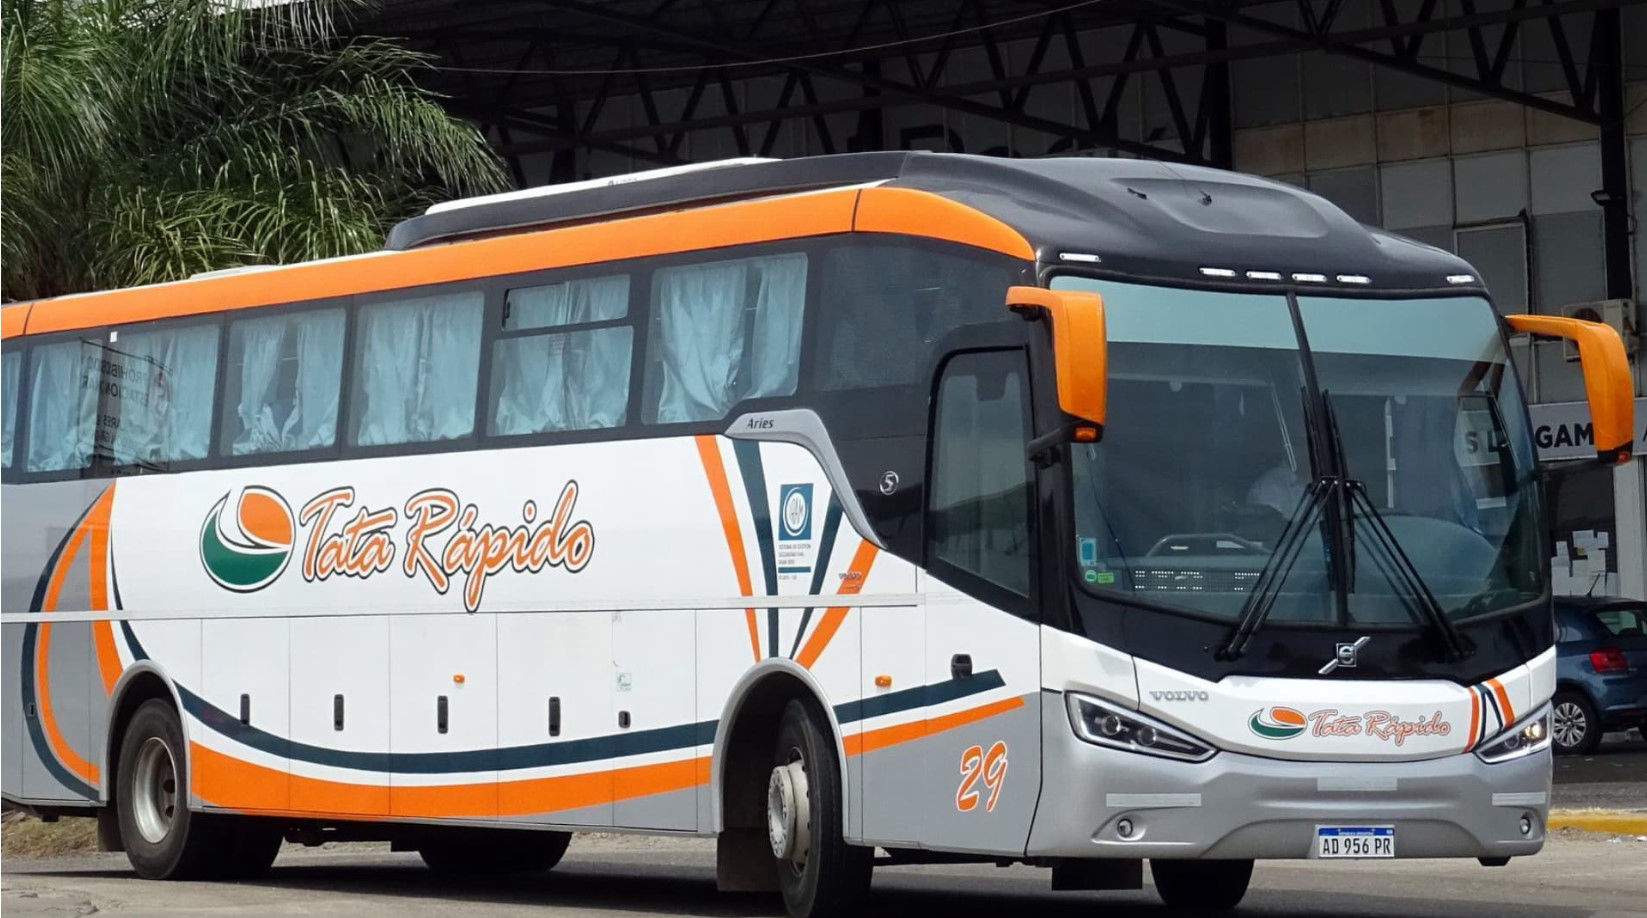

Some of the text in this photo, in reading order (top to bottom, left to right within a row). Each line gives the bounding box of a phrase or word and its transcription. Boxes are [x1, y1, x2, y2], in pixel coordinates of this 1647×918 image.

[746, 417, 774, 430] Aries
[300, 479, 595, 613] Tata Rápido
[1149, 690, 1209, 701] VOLVO
[1308, 709, 1451, 747] Tata Rápido
[955, 740, 1009, 813] 29
[1322, 837, 1391, 855] AD 956 PR
